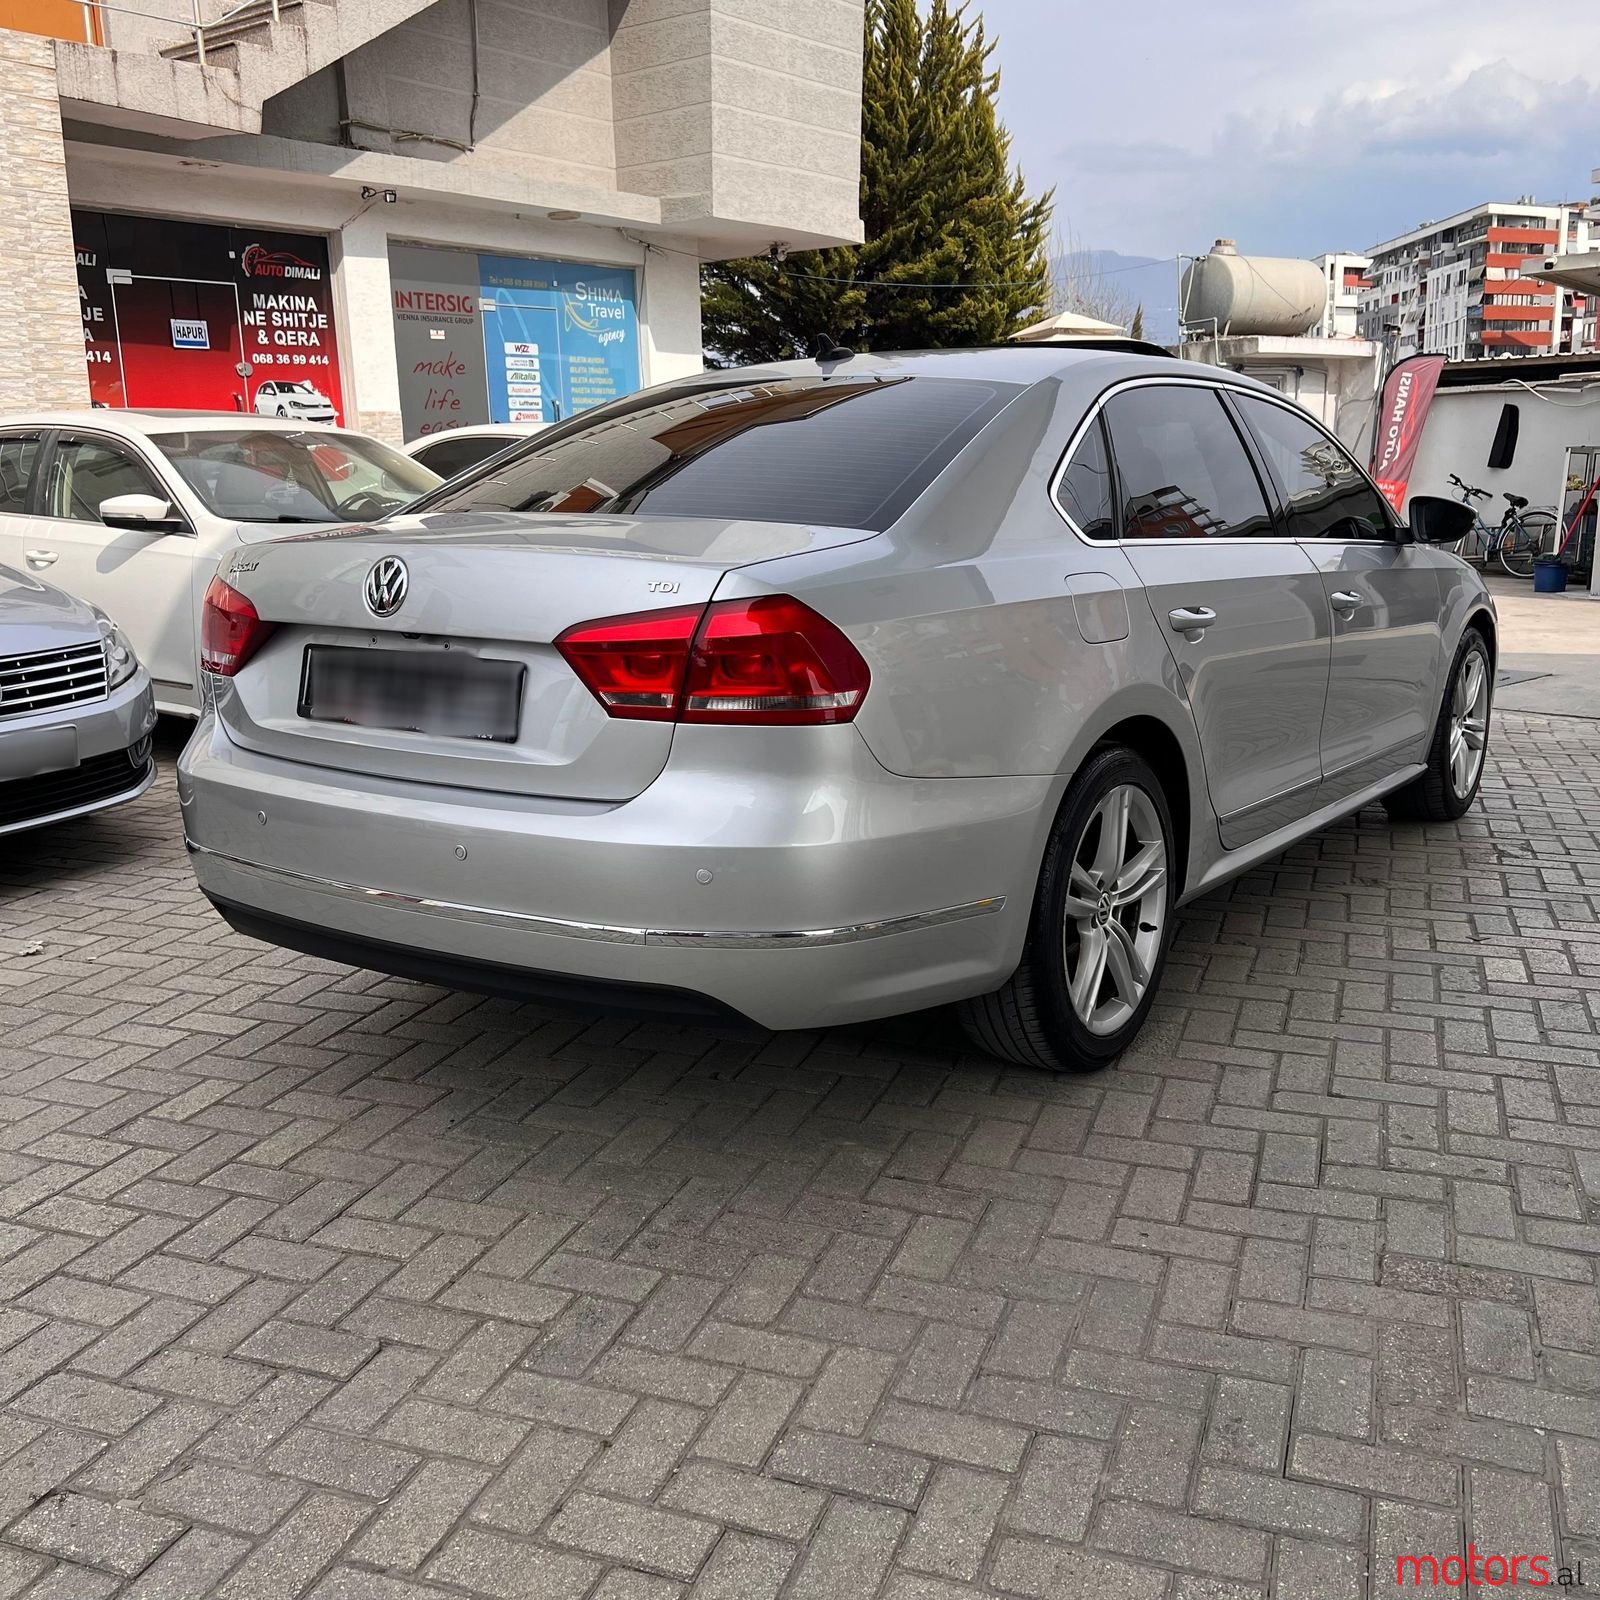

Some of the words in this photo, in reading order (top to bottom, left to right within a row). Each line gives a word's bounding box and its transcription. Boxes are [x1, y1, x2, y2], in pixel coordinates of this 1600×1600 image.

[576, 282, 623, 303] SHIMA
[252, 293, 318, 312] MAKINA
[395, 290, 473, 313] INTERSIG
[83, 306, 104, 321] JE
[243, 310, 267, 326] NE
[271, 311, 328, 328] SHITJE
[396, 313, 419, 321] VIENNA
[420, 314, 453, 324] INSURANCE
[454, 317, 474, 325] GROUP
[587, 303, 625, 319] Travel
[175, 325, 204, 339] HAPUR
[257, 329, 269, 344] &
[273, 330, 320, 346] QERA
[598, 329, 625, 346] agency
[86, 350, 112, 363] 414
[252, 353, 273, 364] 068
[276, 354, 290, 364] 36
[292, 354, 306, 365] 99
[309, 355, 329, 365] 414
[413, 351, 466, 378] make
[510, 372, 537, 381] Alitalia
[424, 388, 461, 410] life
[648, 581, 680, 594] TDI
